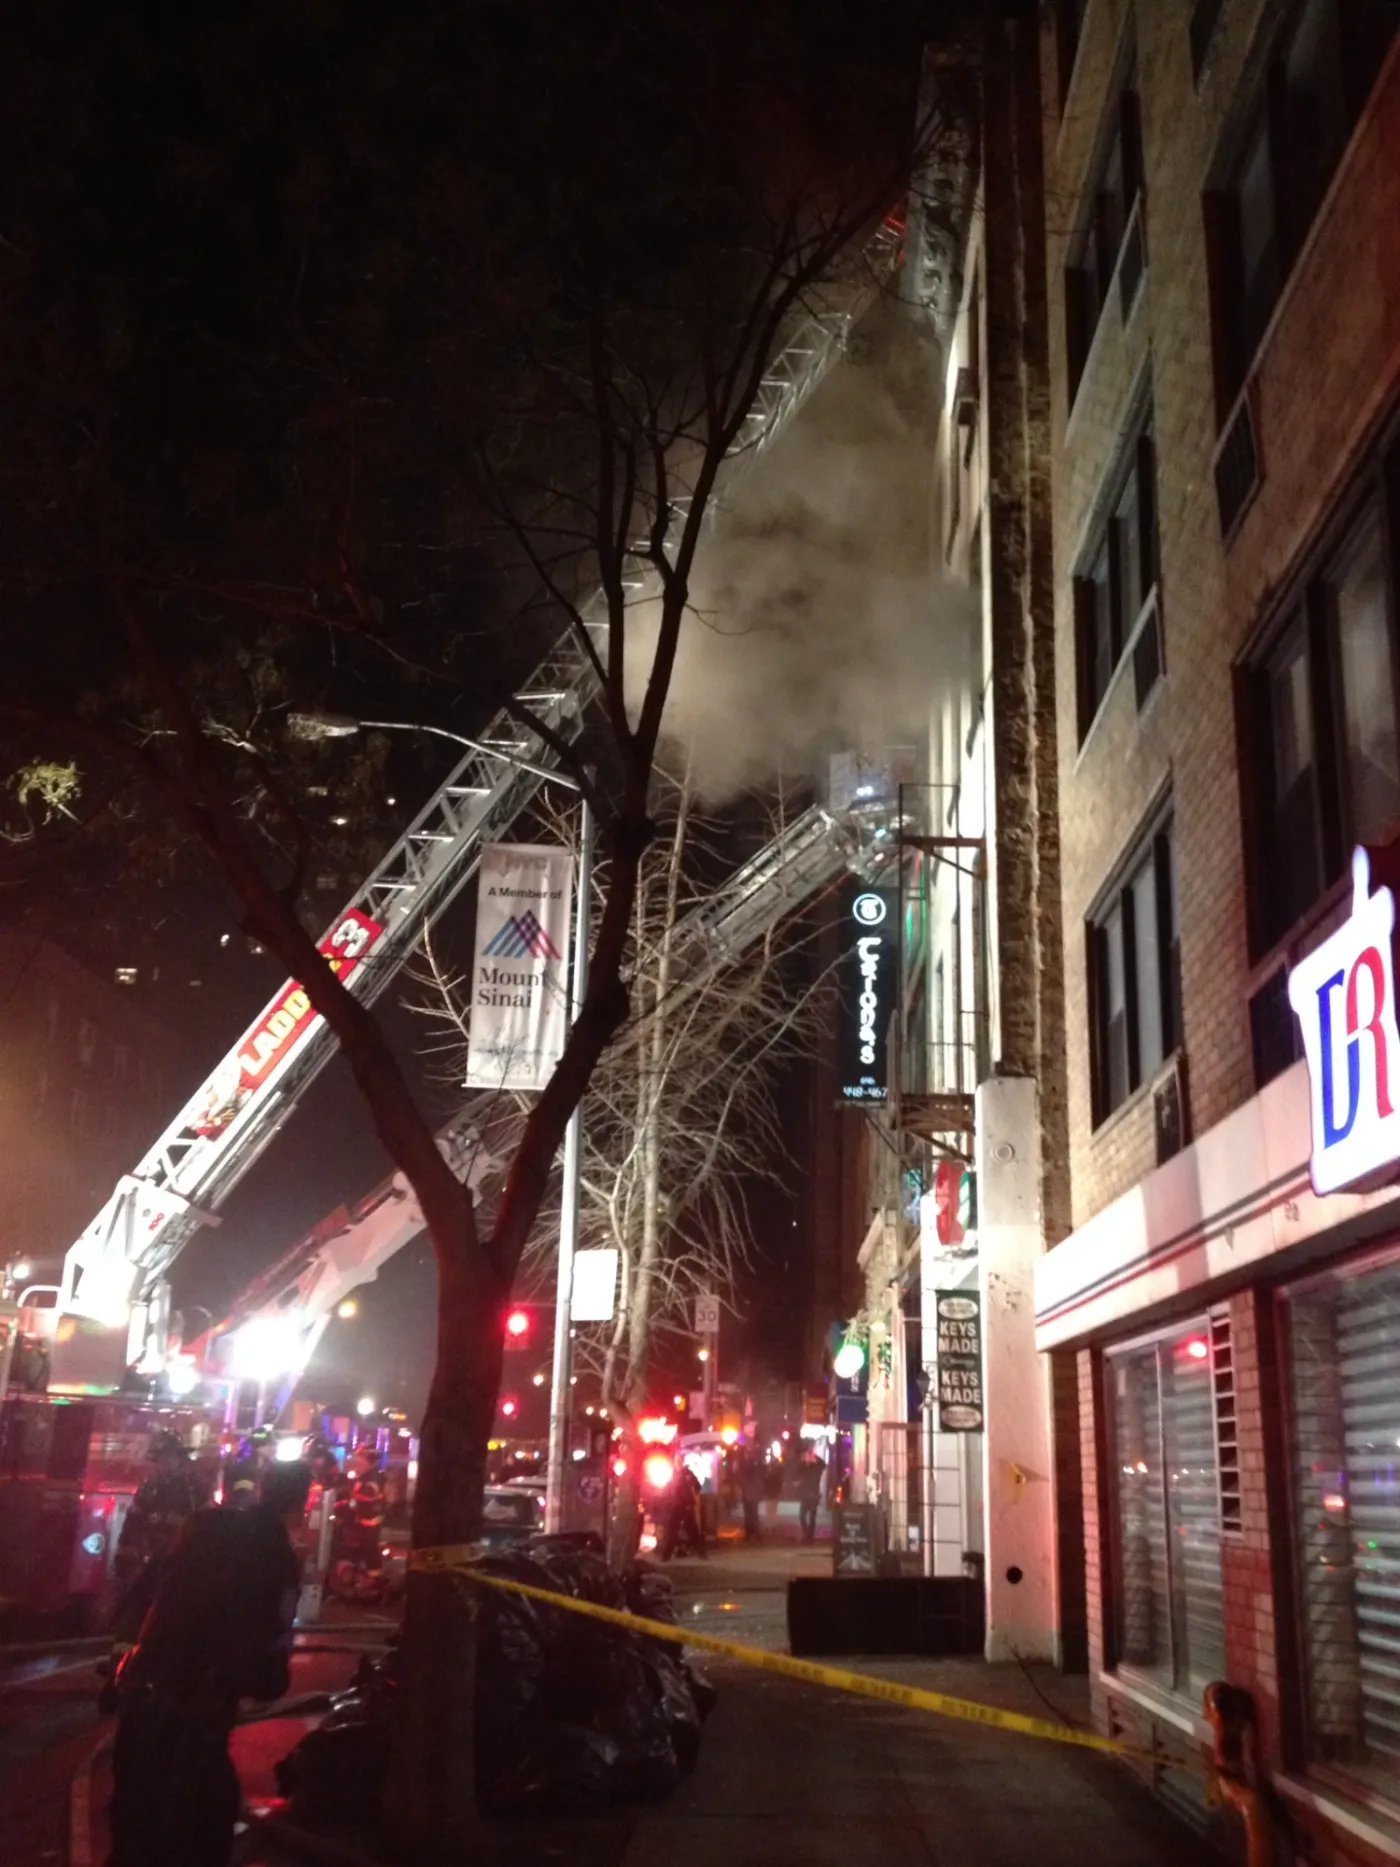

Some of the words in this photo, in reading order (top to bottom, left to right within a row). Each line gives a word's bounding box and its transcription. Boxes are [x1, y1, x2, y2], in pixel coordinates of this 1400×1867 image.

[488, 887, 496, 897] A
[499, 888, 547, 899] Member
[550, 889, 562, 899] of
[332, 918, 370, 958] 3
[478, 967, 548, 987] Mount
[477, 988, 532, 1008] Sinai
[843, 1086, 888, 1098] 448-467
[940, 1321, 976, 1337] KEYS
[938, 1338, 979, 1354] MADE
[942, 1370, 978, 1386] KEYS
[941, 1387, 981, 1403] MADE
